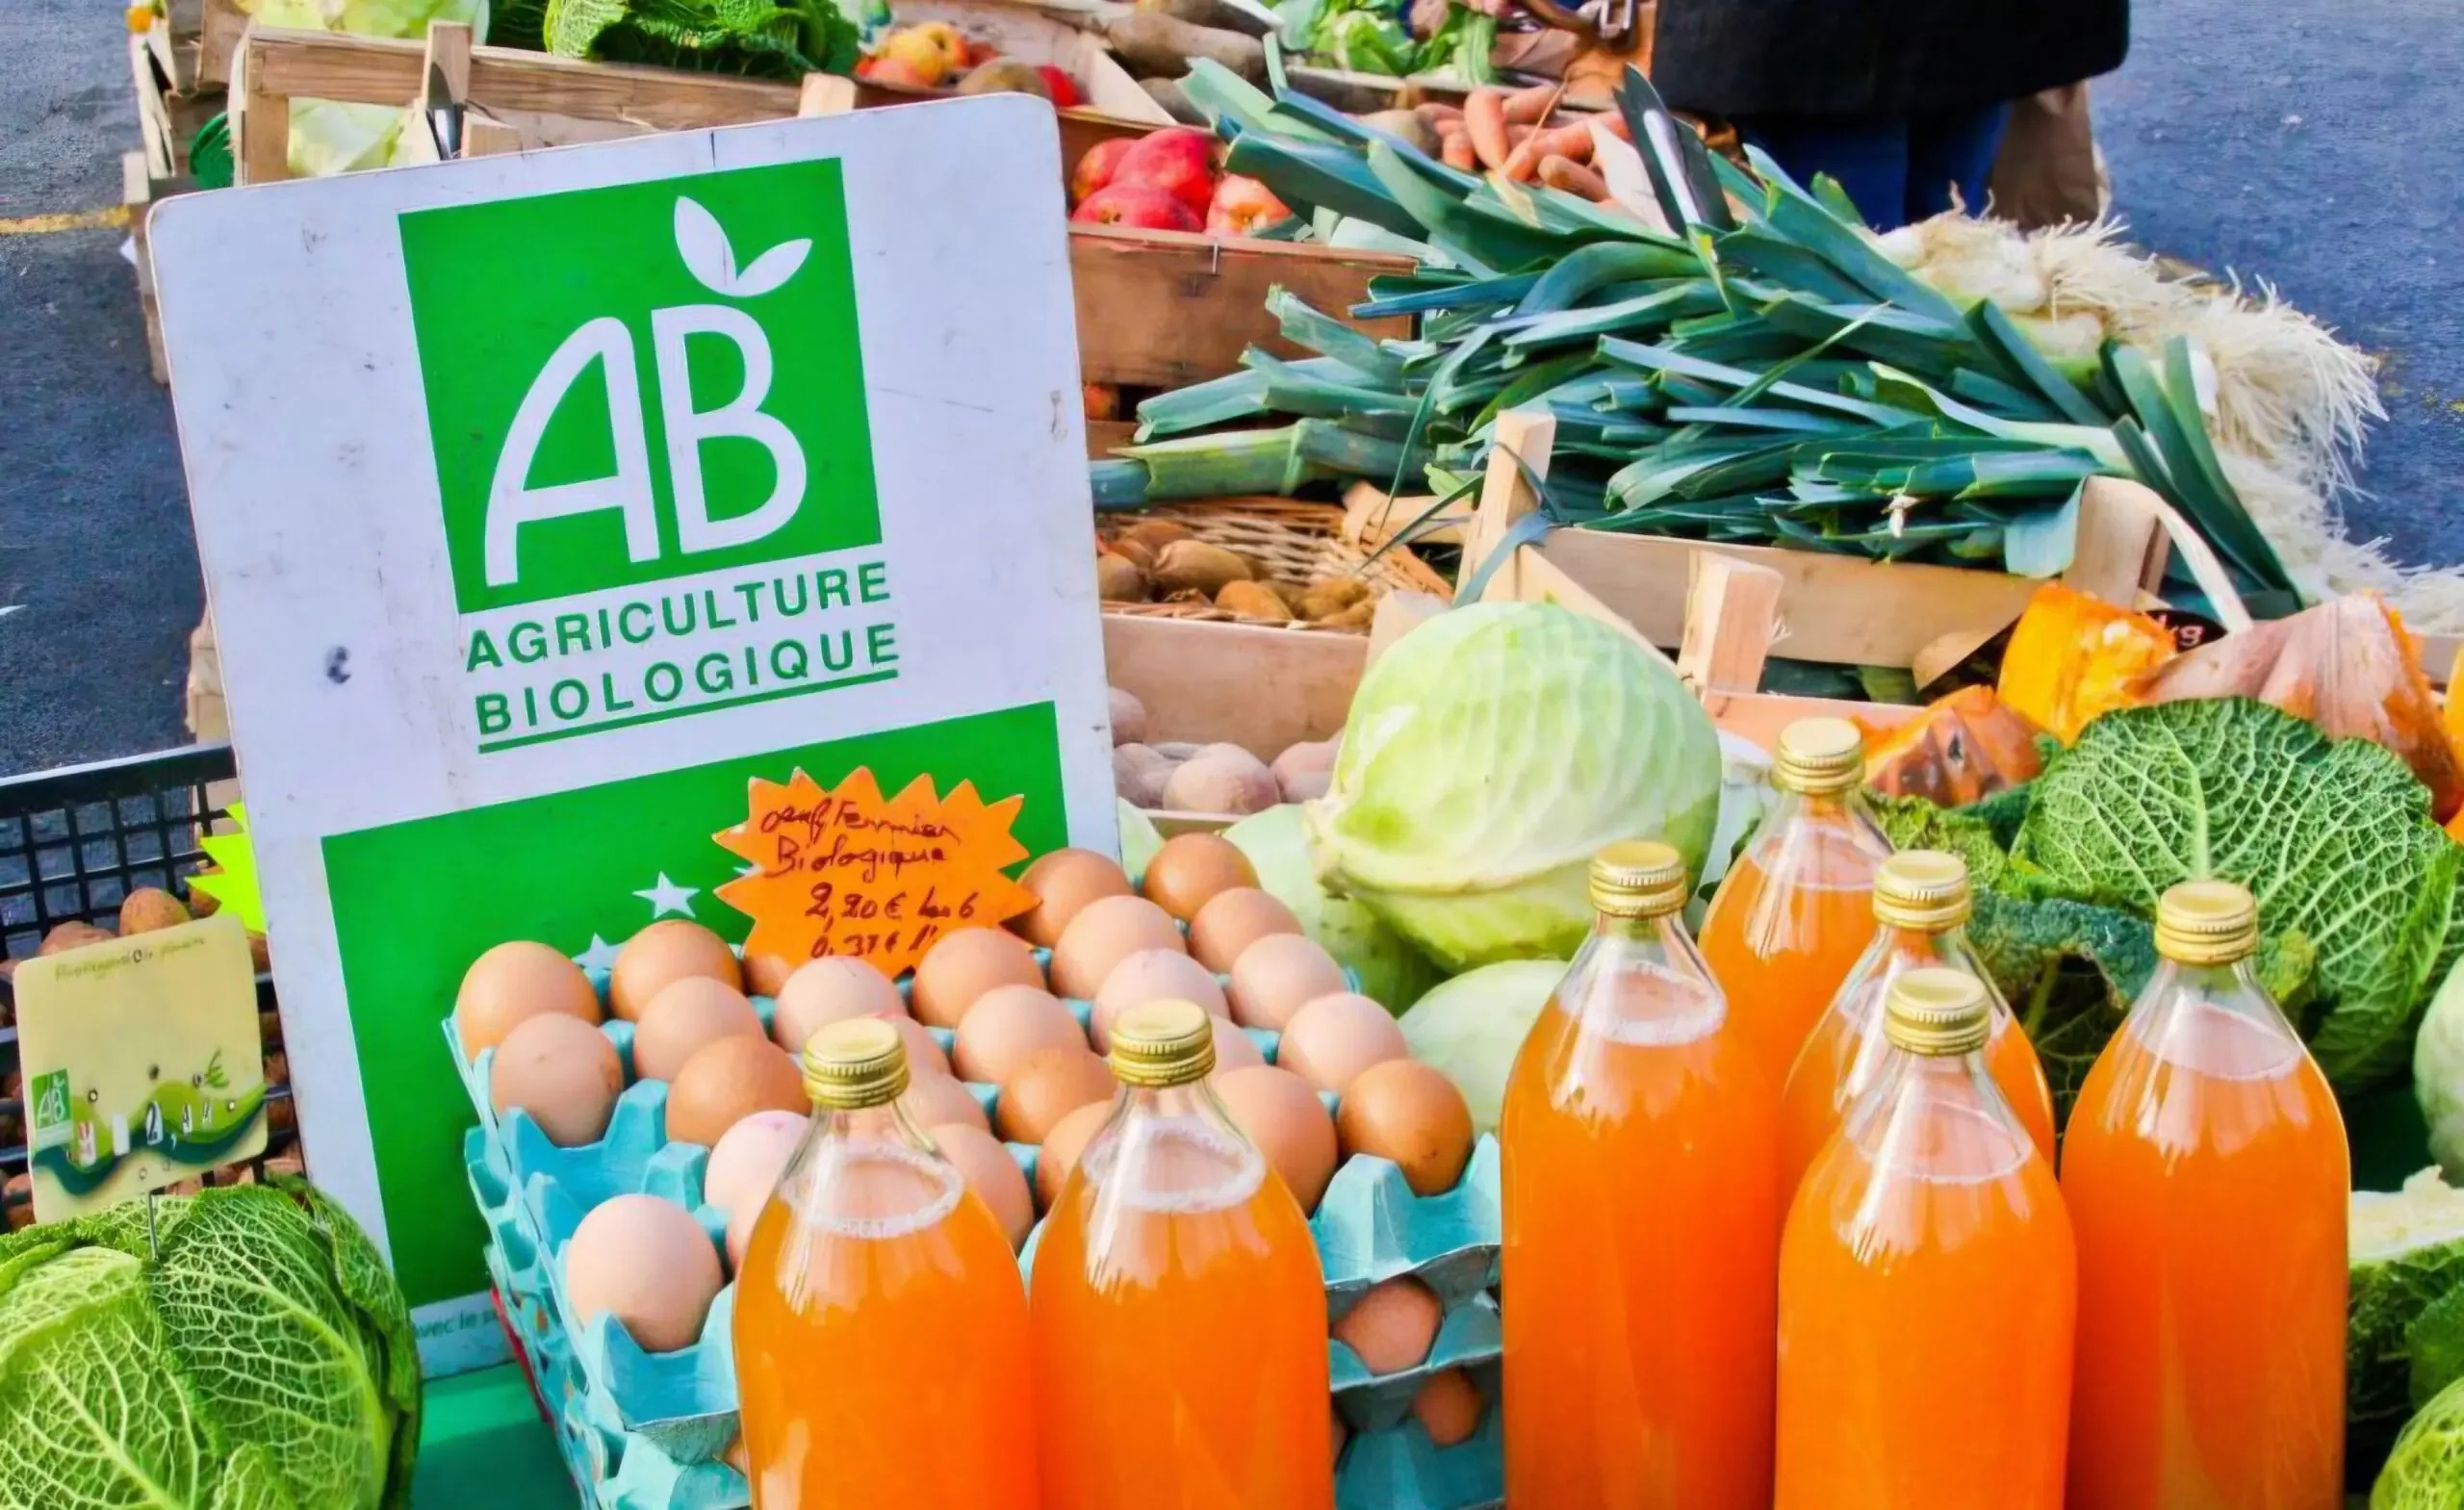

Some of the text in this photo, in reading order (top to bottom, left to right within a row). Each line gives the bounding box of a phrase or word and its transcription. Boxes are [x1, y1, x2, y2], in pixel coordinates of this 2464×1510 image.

[484, 303, 807, 588] AB
[466, 561, 891, 673] AGRICULTURE
[475, 623, 900, 735] BIOLOGIQUE
[413, 1318, 455, 1339] vec
